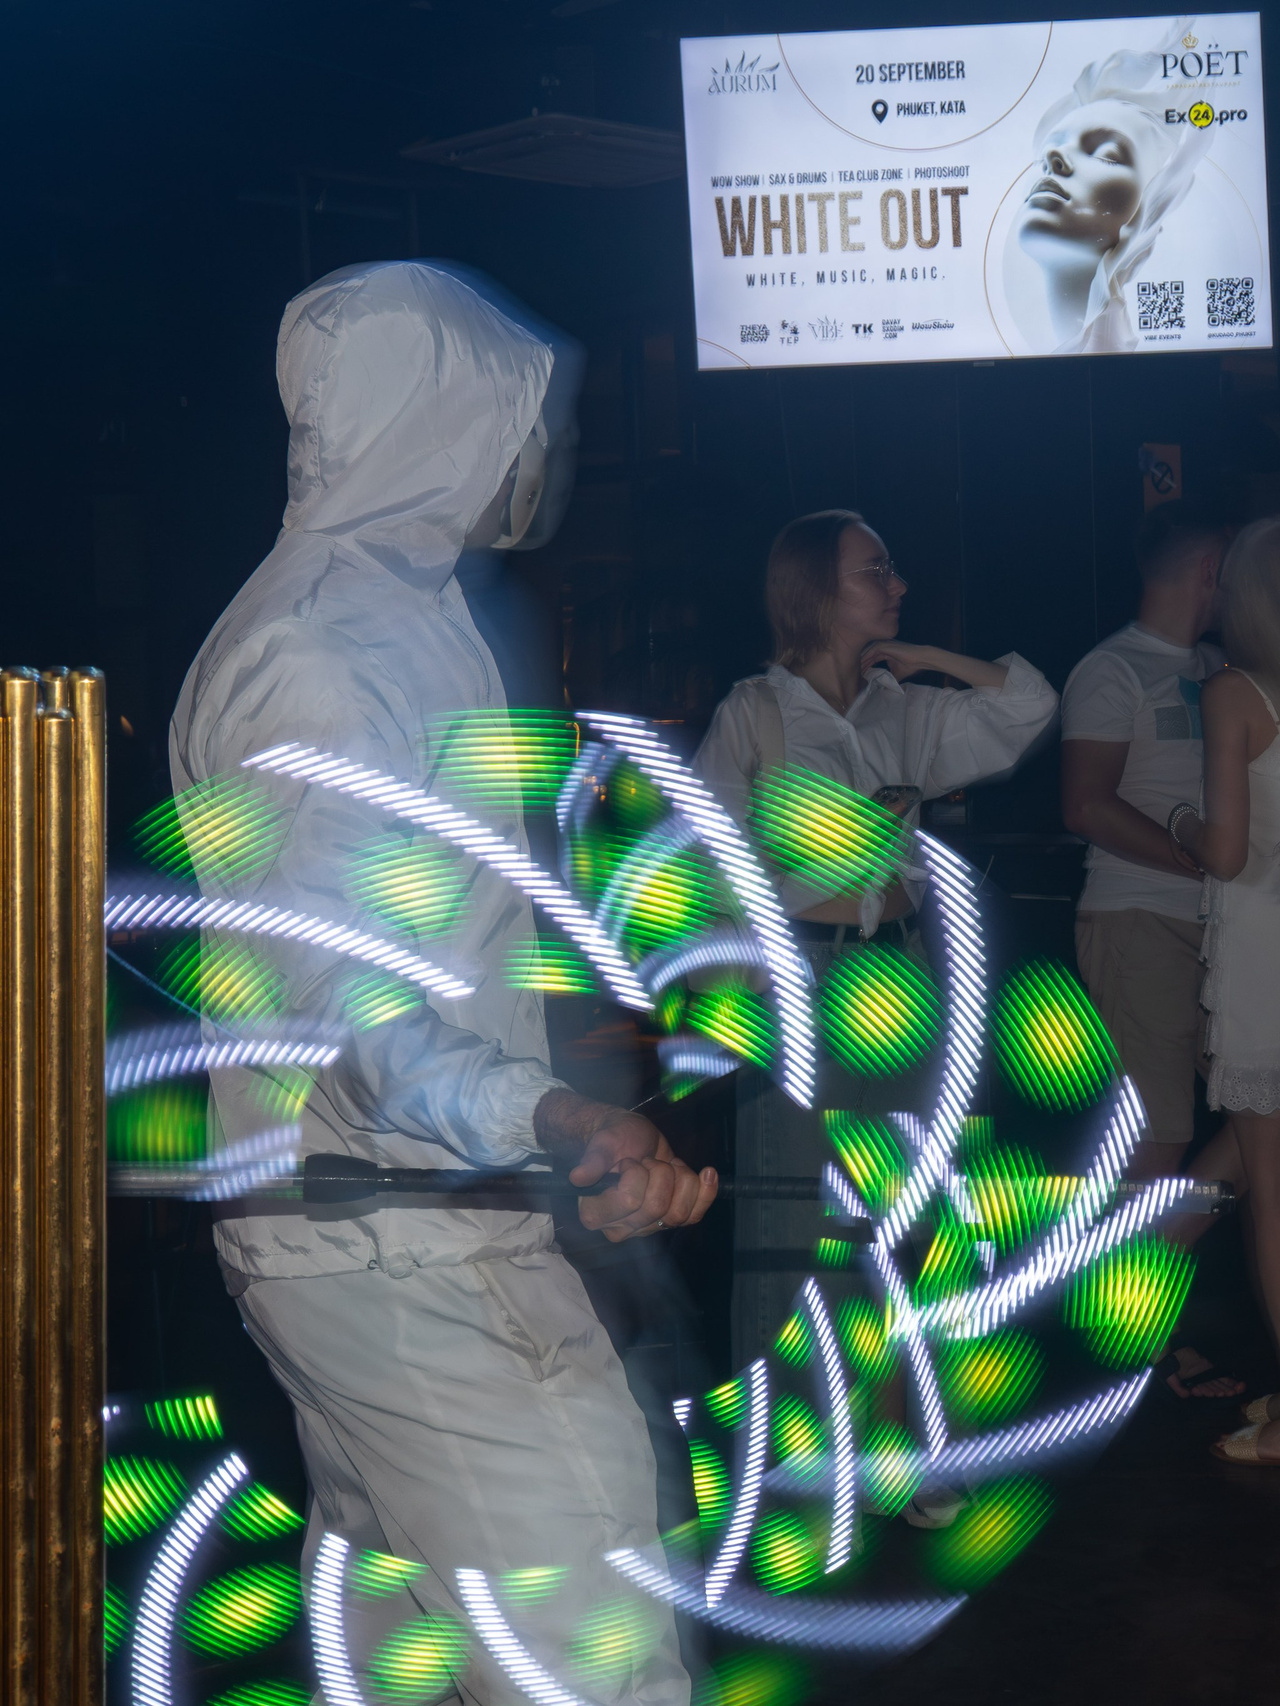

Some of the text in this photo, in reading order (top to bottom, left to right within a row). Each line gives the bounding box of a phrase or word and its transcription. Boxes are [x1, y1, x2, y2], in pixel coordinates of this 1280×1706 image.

[856, 60, 966, 83] 20 SEPTEMBER
[1161, 44, 1249, 78] POËT
[897, 100, 966, 117] PHUKET, KATA
[711, 165, 970, 188] WOW SHOW SAX & DRUMS TEA CLUB ZONE PHOTOSHOOT
[715, 186, 969, 257] WHITE OUT
[886, 266, 946, 282] MAGIC.
[852, 323, 874, 334] TK
